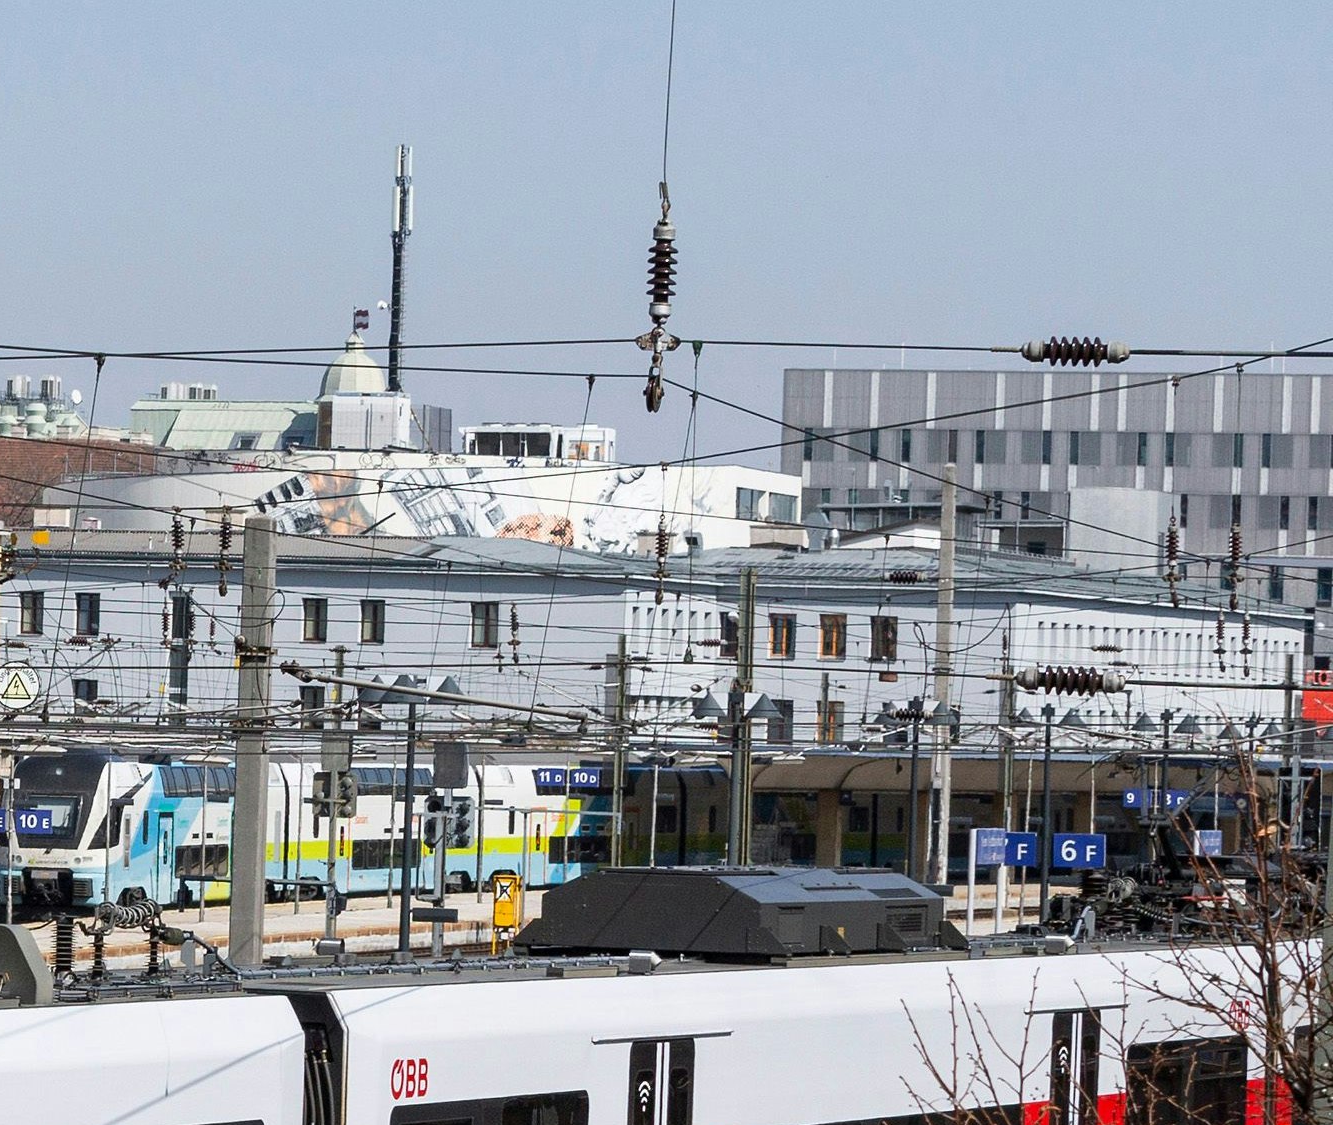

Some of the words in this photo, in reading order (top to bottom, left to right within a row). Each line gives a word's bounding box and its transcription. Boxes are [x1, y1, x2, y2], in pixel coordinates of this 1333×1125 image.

[539, 772, 550, 783] 11
[555, 774, 562, 783] D
[573, 772, 587, 783] 10
[590, 774, 596, 783] D
[1126, 793, 1135, 804] 9
[19, 814, 38, 829] 10
[42, 818, 50, 829] E
[1017, 844, 1028, 860] F
[1061, 840, 1077, 862] 6
[1086, 845, 1097, 862] F
[391, 1057, 429, 1100] ÖBB
